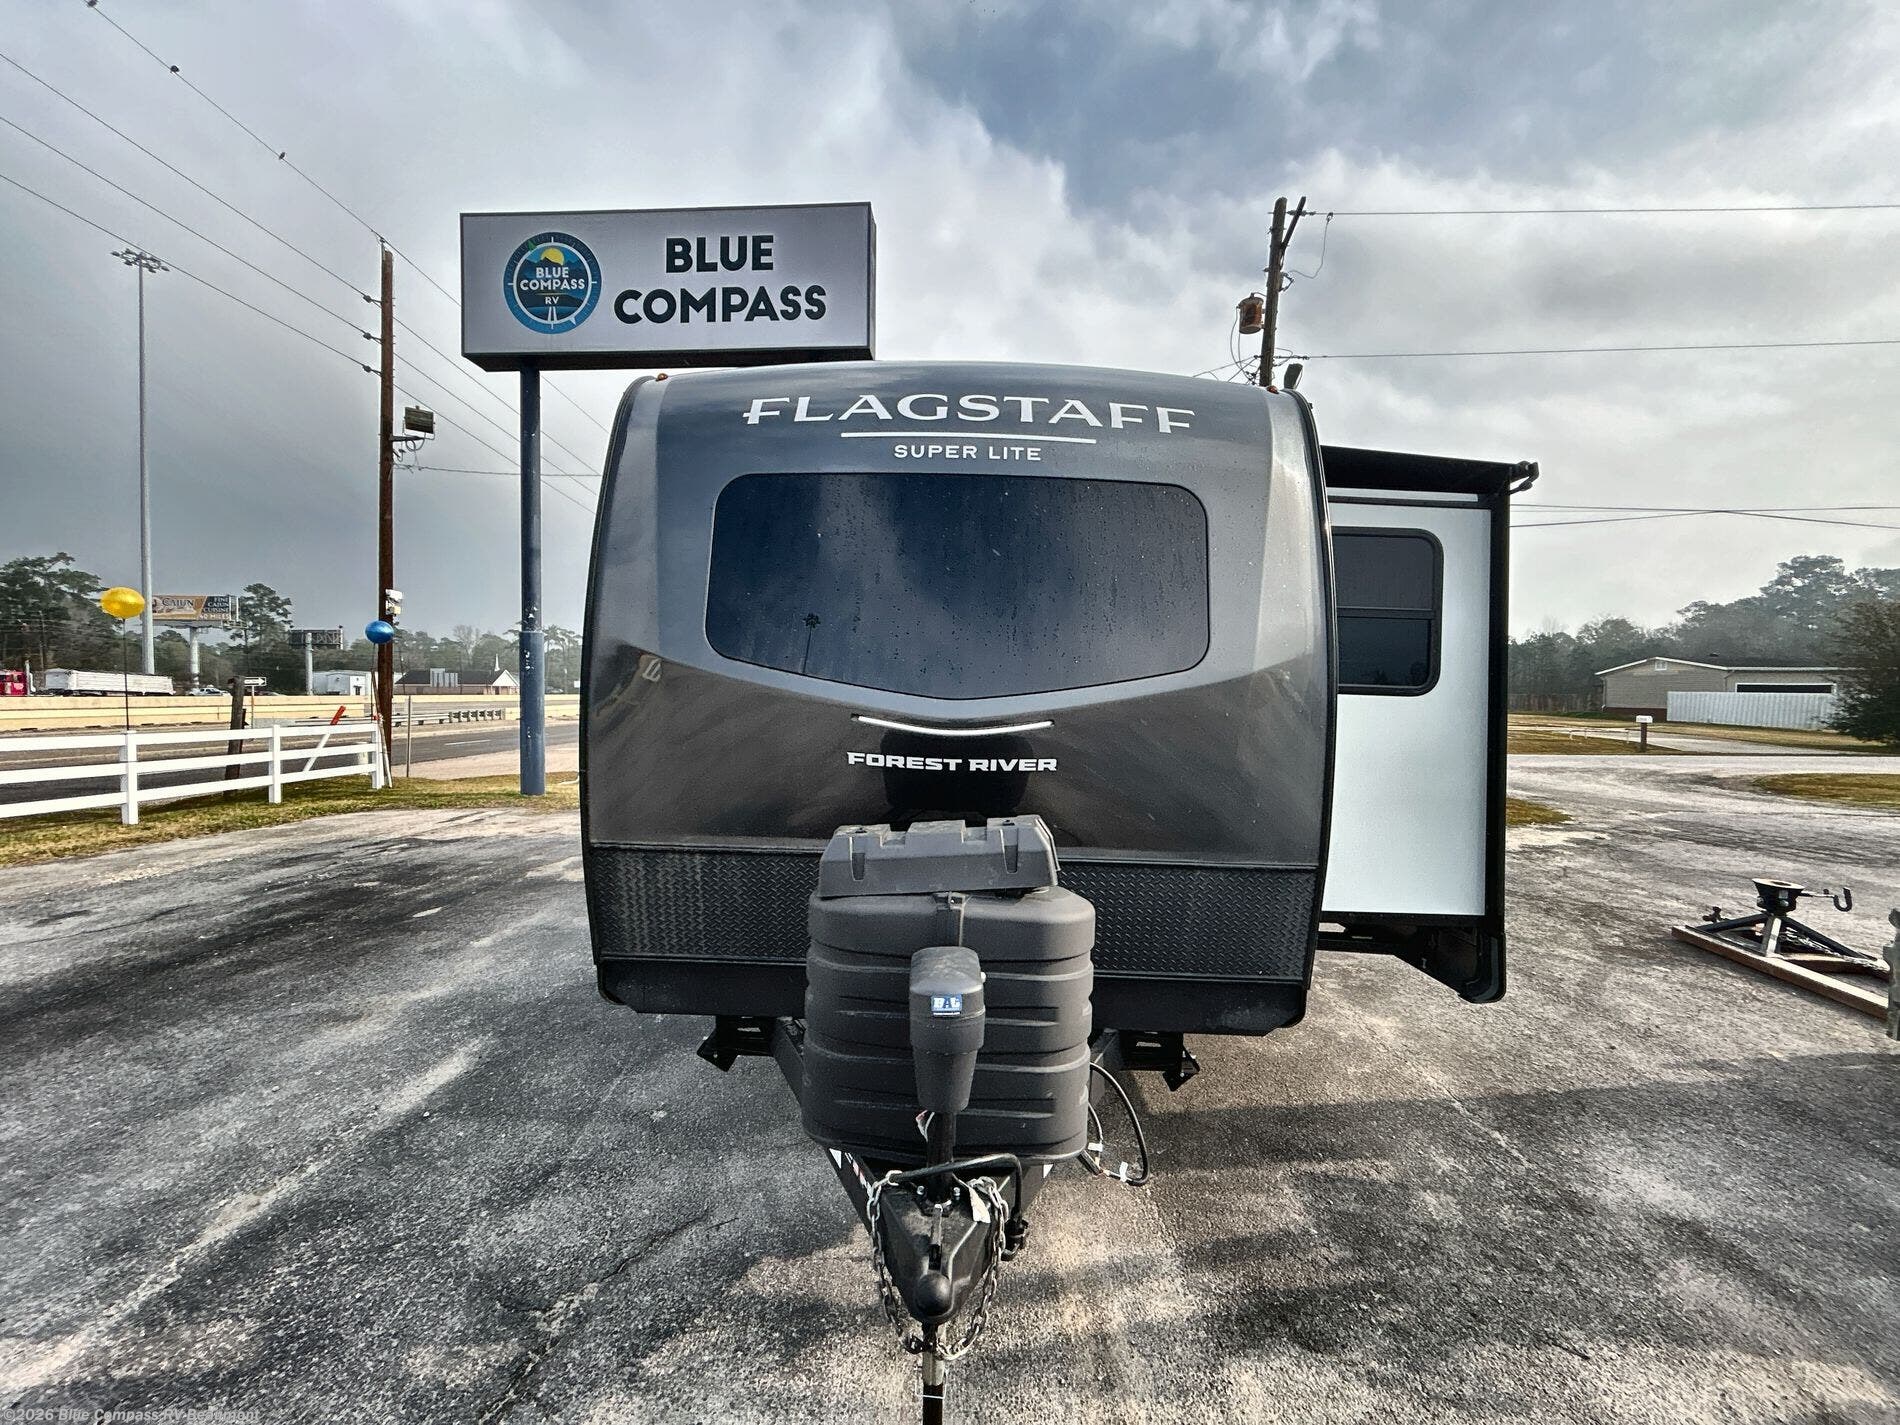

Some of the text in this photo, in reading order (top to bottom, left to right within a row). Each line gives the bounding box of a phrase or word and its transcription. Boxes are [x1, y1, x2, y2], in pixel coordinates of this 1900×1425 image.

[666, 235, 774, 273] BLUE
[535, 266, 570, 278] BLUE
[519, 279, 586, 291] COMPASS
[544, 296, 560, 305] RV
[613, 284, 827, 325] COMPASS
[742, 393, 1196, 434] FLAGSTAFF
[894, 444, 1042, 462] SUPER LITE
[847, 752, 1057, 772] FOREST RIVER
